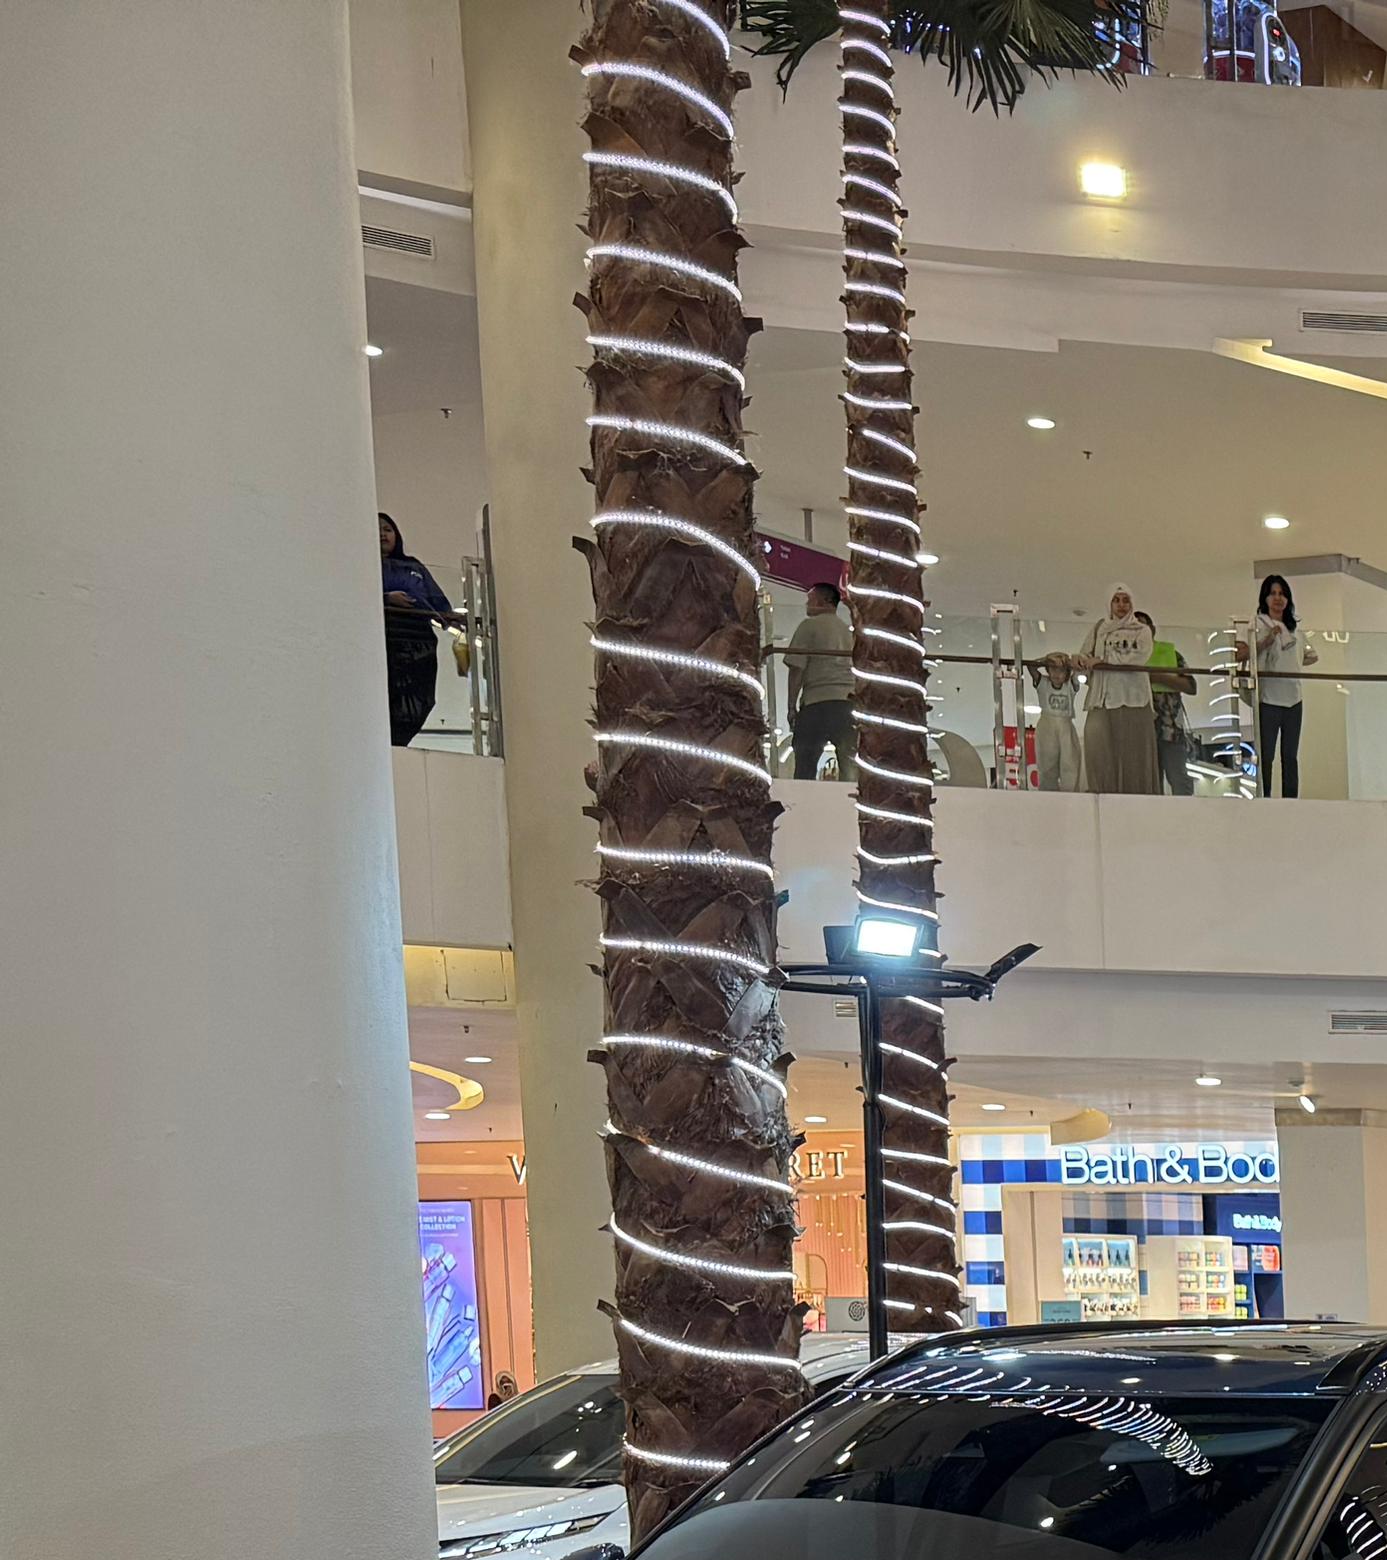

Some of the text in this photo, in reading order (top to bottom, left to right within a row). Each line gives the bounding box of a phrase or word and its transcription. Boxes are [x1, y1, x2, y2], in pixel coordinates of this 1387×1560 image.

[789, 1151, 848, 1178] RET
[1059, 1144, 1280, 1184] Bath & Bod
